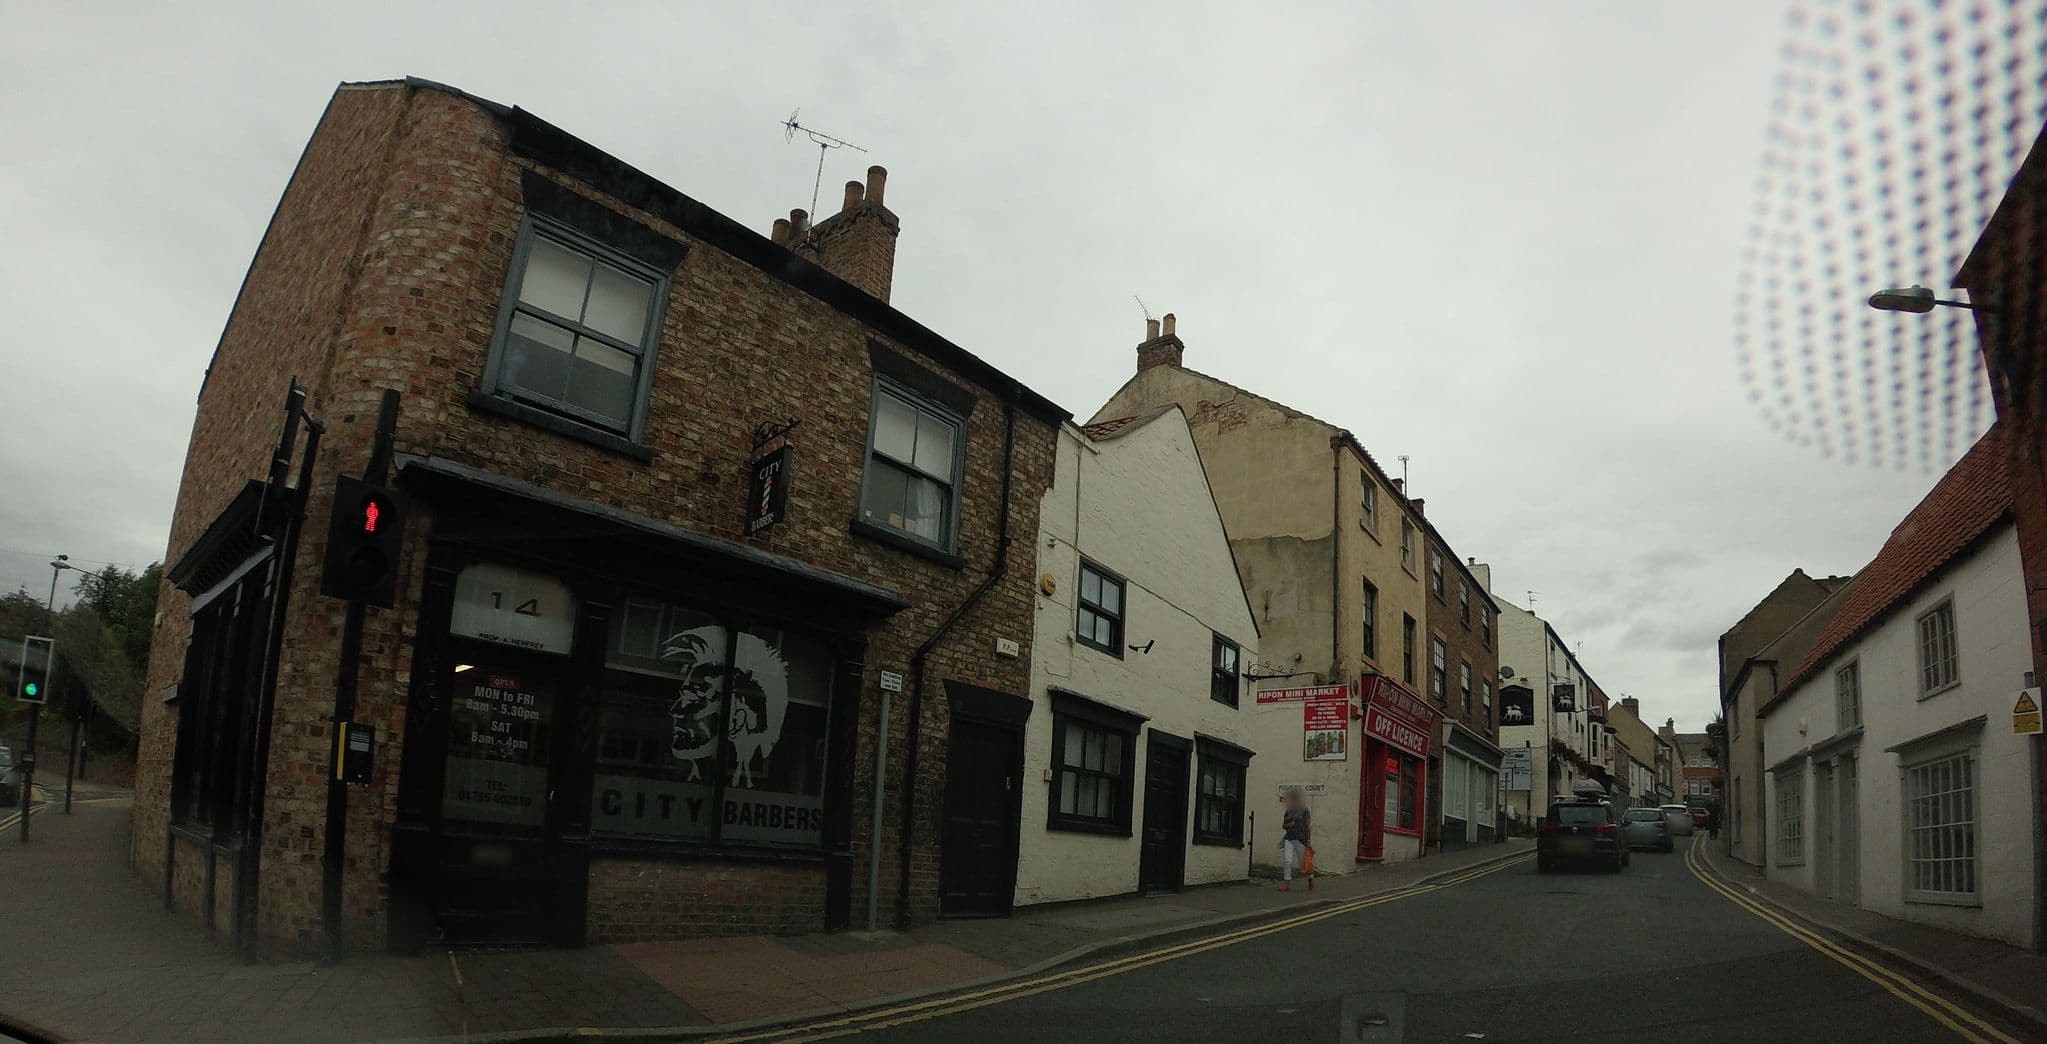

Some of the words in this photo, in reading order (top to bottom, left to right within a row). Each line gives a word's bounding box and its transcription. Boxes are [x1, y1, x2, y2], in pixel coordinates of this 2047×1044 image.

[760, 459, 781, 480] CITY
[491, 591, 542, 617] 14
[495, 678, 515, 687] OPEN
[474, 686, 500, 701] MON
[503, 690, 514, 702] to
[517, 692, 535, 706] FRI
[1258, 691, 1283, 700] RIPON
[1285, 690, 1303, 698] MINI
[1305, 687, 1340, 697] MARKET
[465, 698, 489, 712] 8am
[500, 704, 541, 720] 5.30pm
[491, 720, 512, 734] SAT
[1375, 714, 1392, 736] OFF
[1392, 723, 1424, 752] LICENCE
[471, 731, 494, 744] 8am
[505, 736, 528, 750] 4pm
[601, 789, 704, 823] CITY
[723, 800, 824, 832] BARBERS
